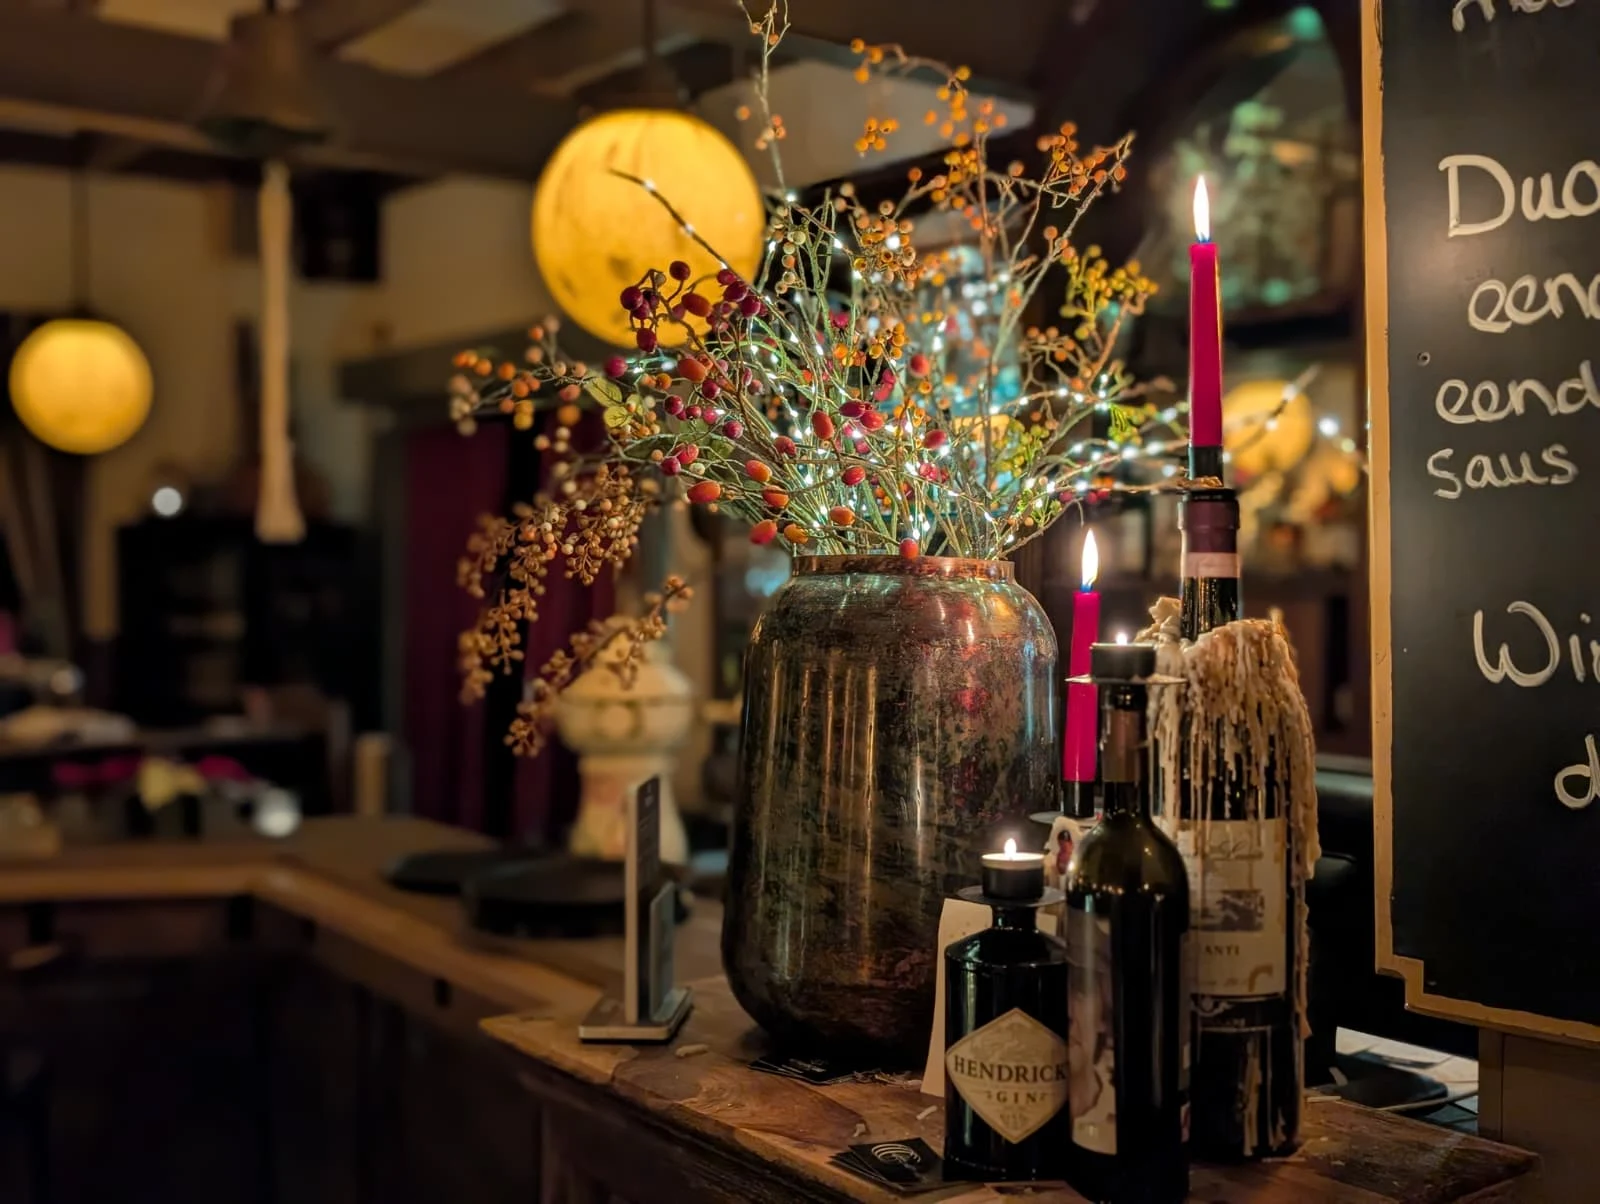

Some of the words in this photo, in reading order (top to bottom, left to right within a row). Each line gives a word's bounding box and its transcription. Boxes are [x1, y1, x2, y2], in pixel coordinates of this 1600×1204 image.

[1437, 154, 1600, 238] Duo
[1473, 600, 1600, 688] Wi
[954, 1055, 1068, 1084] HENDRICK
[996, 1090, 1038, 1105] GIN
